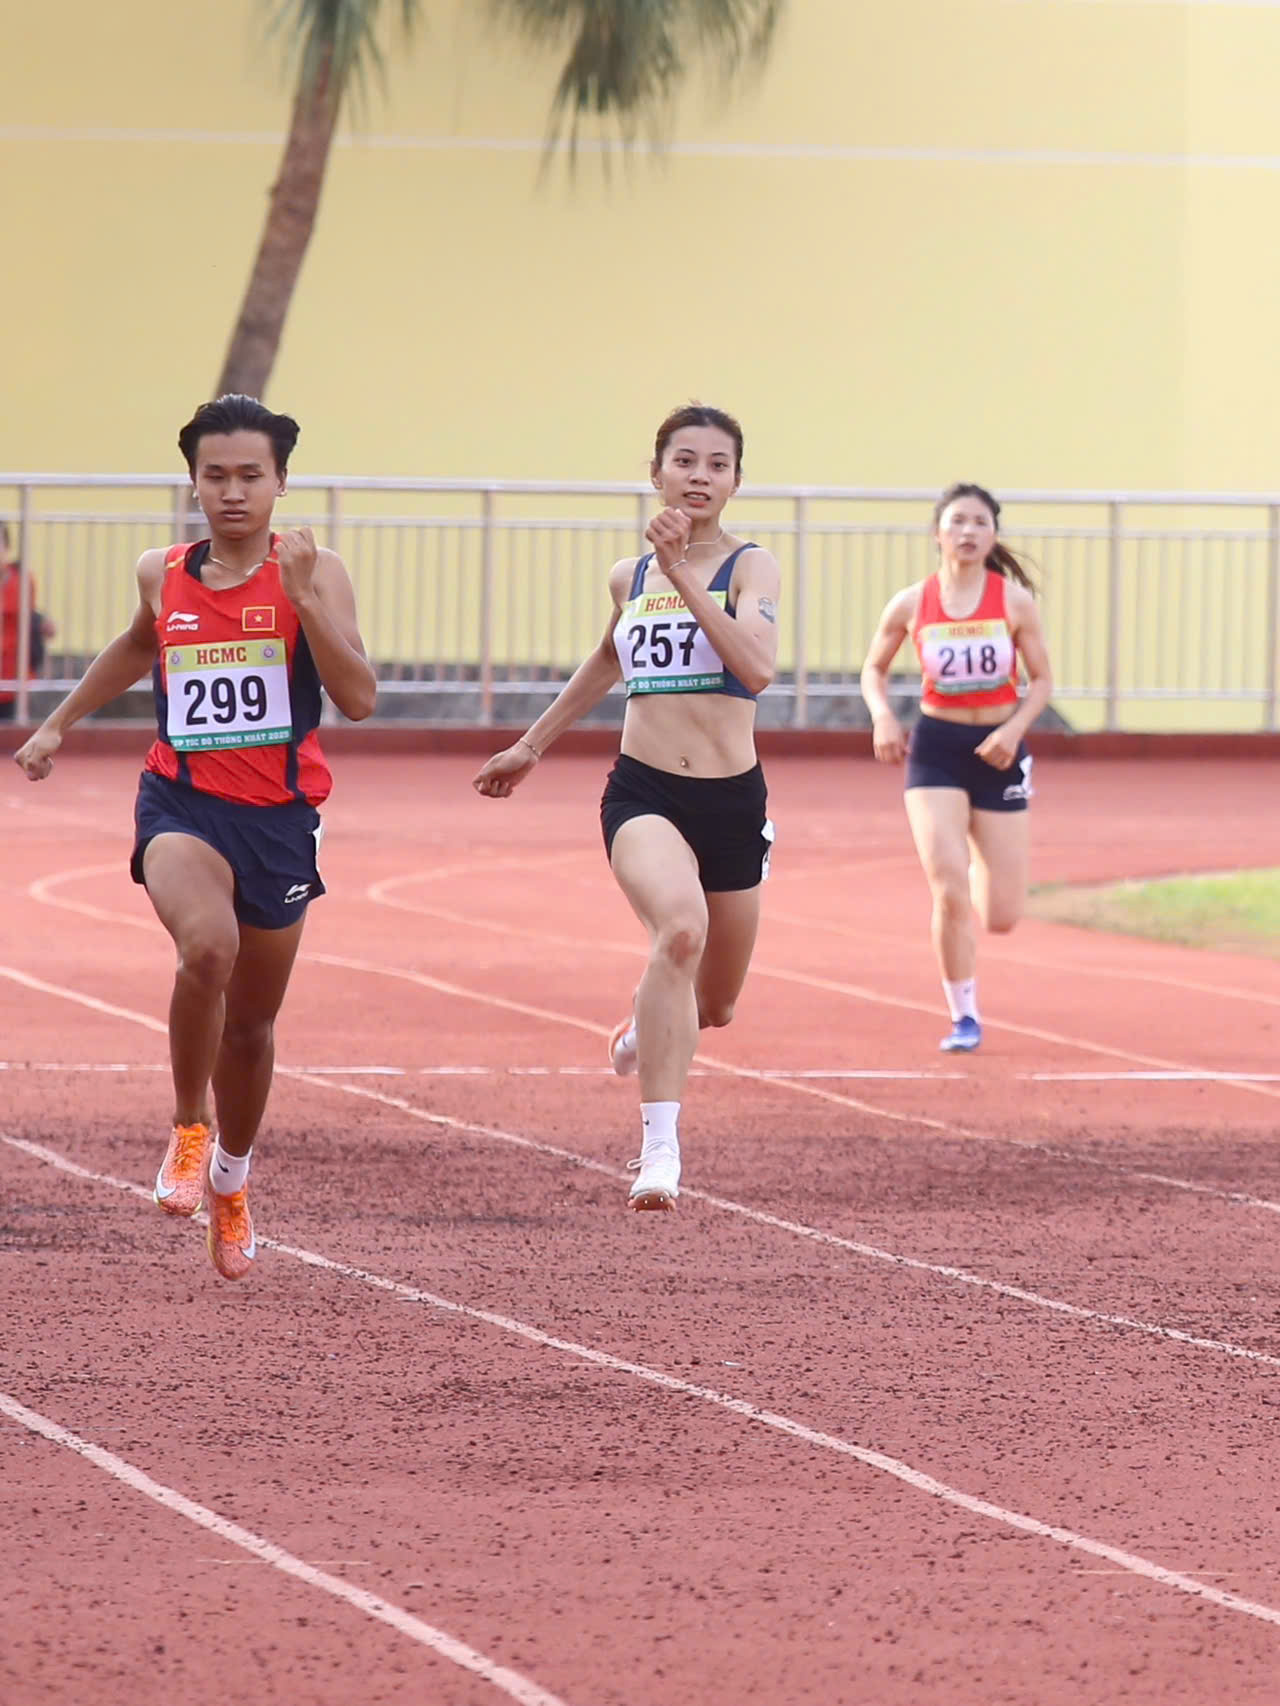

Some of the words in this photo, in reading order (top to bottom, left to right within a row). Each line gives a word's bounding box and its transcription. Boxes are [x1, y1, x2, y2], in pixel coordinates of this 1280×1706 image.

[196, 647, 248, 665] HCMC
[627, 621, 700, 668] 257
[938, 644, 997, 677] 218
[184, 675, 267, 725] 299
